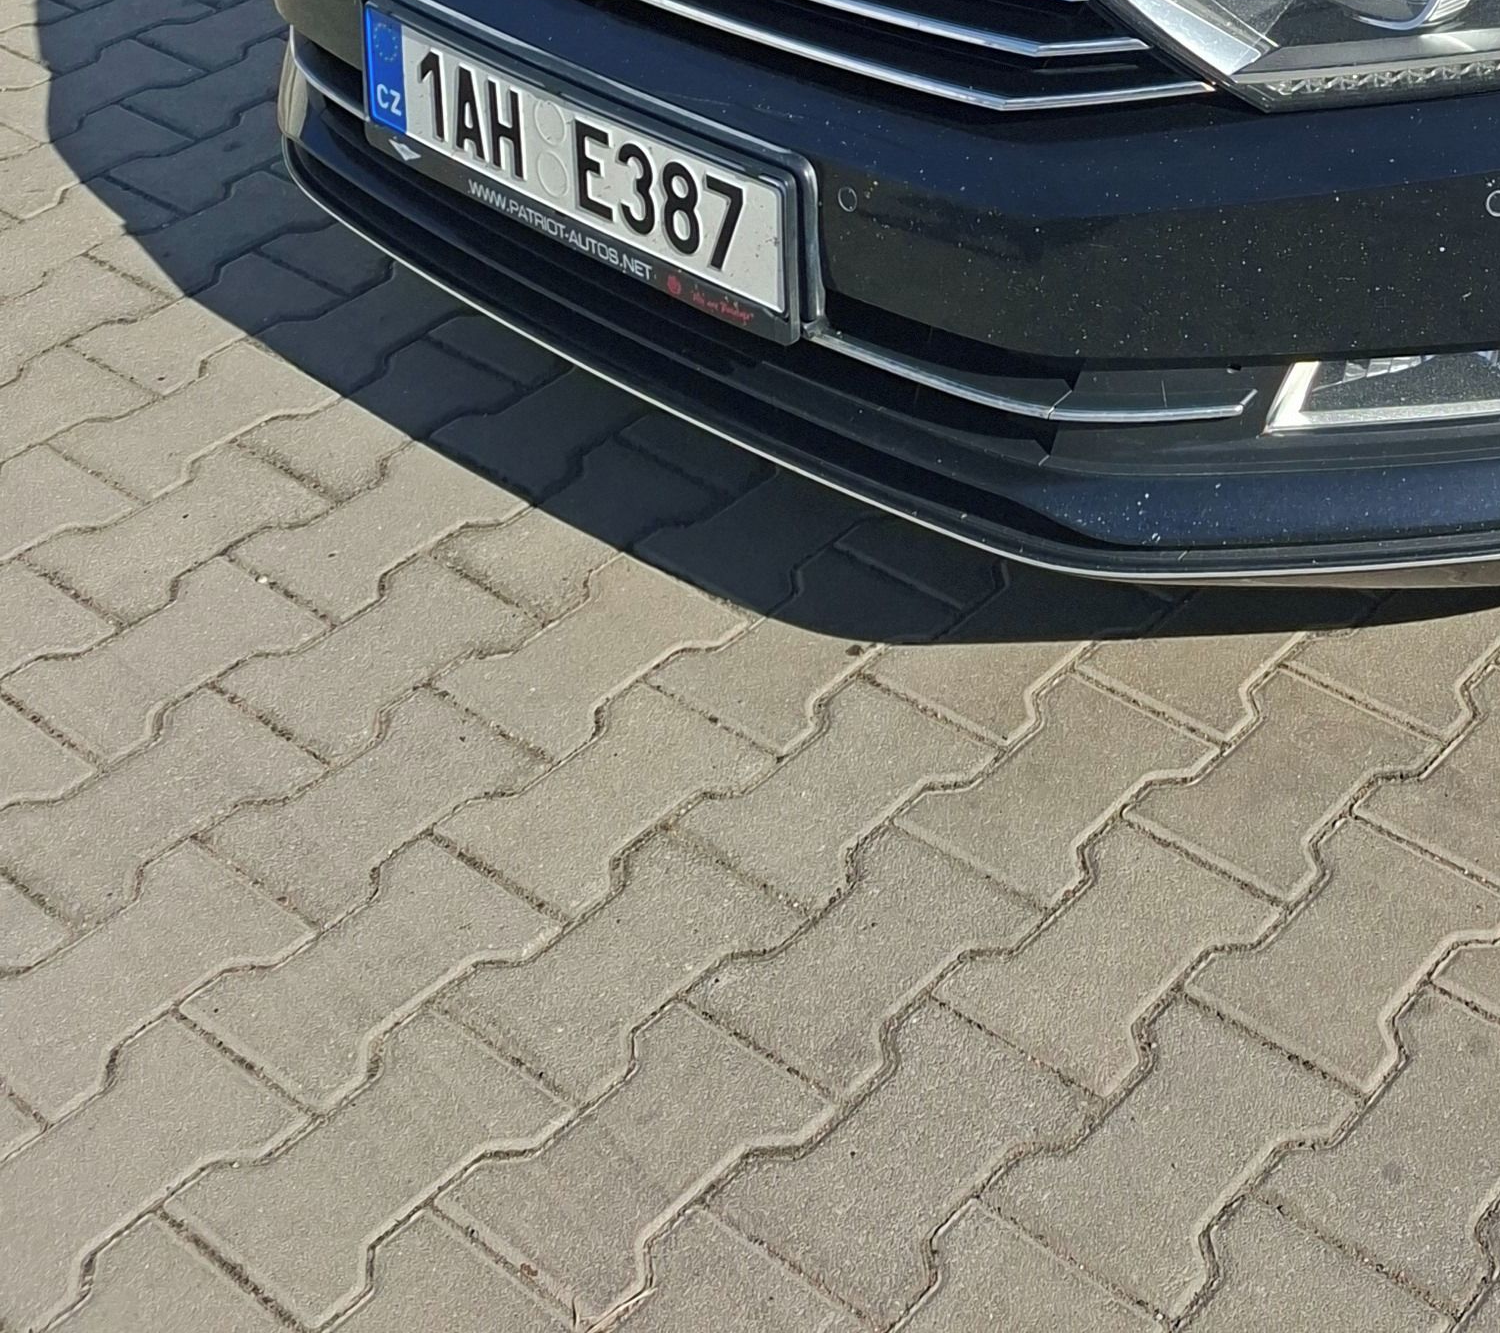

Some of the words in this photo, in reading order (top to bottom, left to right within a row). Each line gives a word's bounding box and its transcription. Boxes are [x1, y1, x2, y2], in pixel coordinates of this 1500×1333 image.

[376, 83, 402, 116] CZ
[420, 49, 526, 180] 1AH
[574, 117, 744, 271] E387
[468, 179, 652, 280] WWW.PATRIOT-AUTOS.NET
